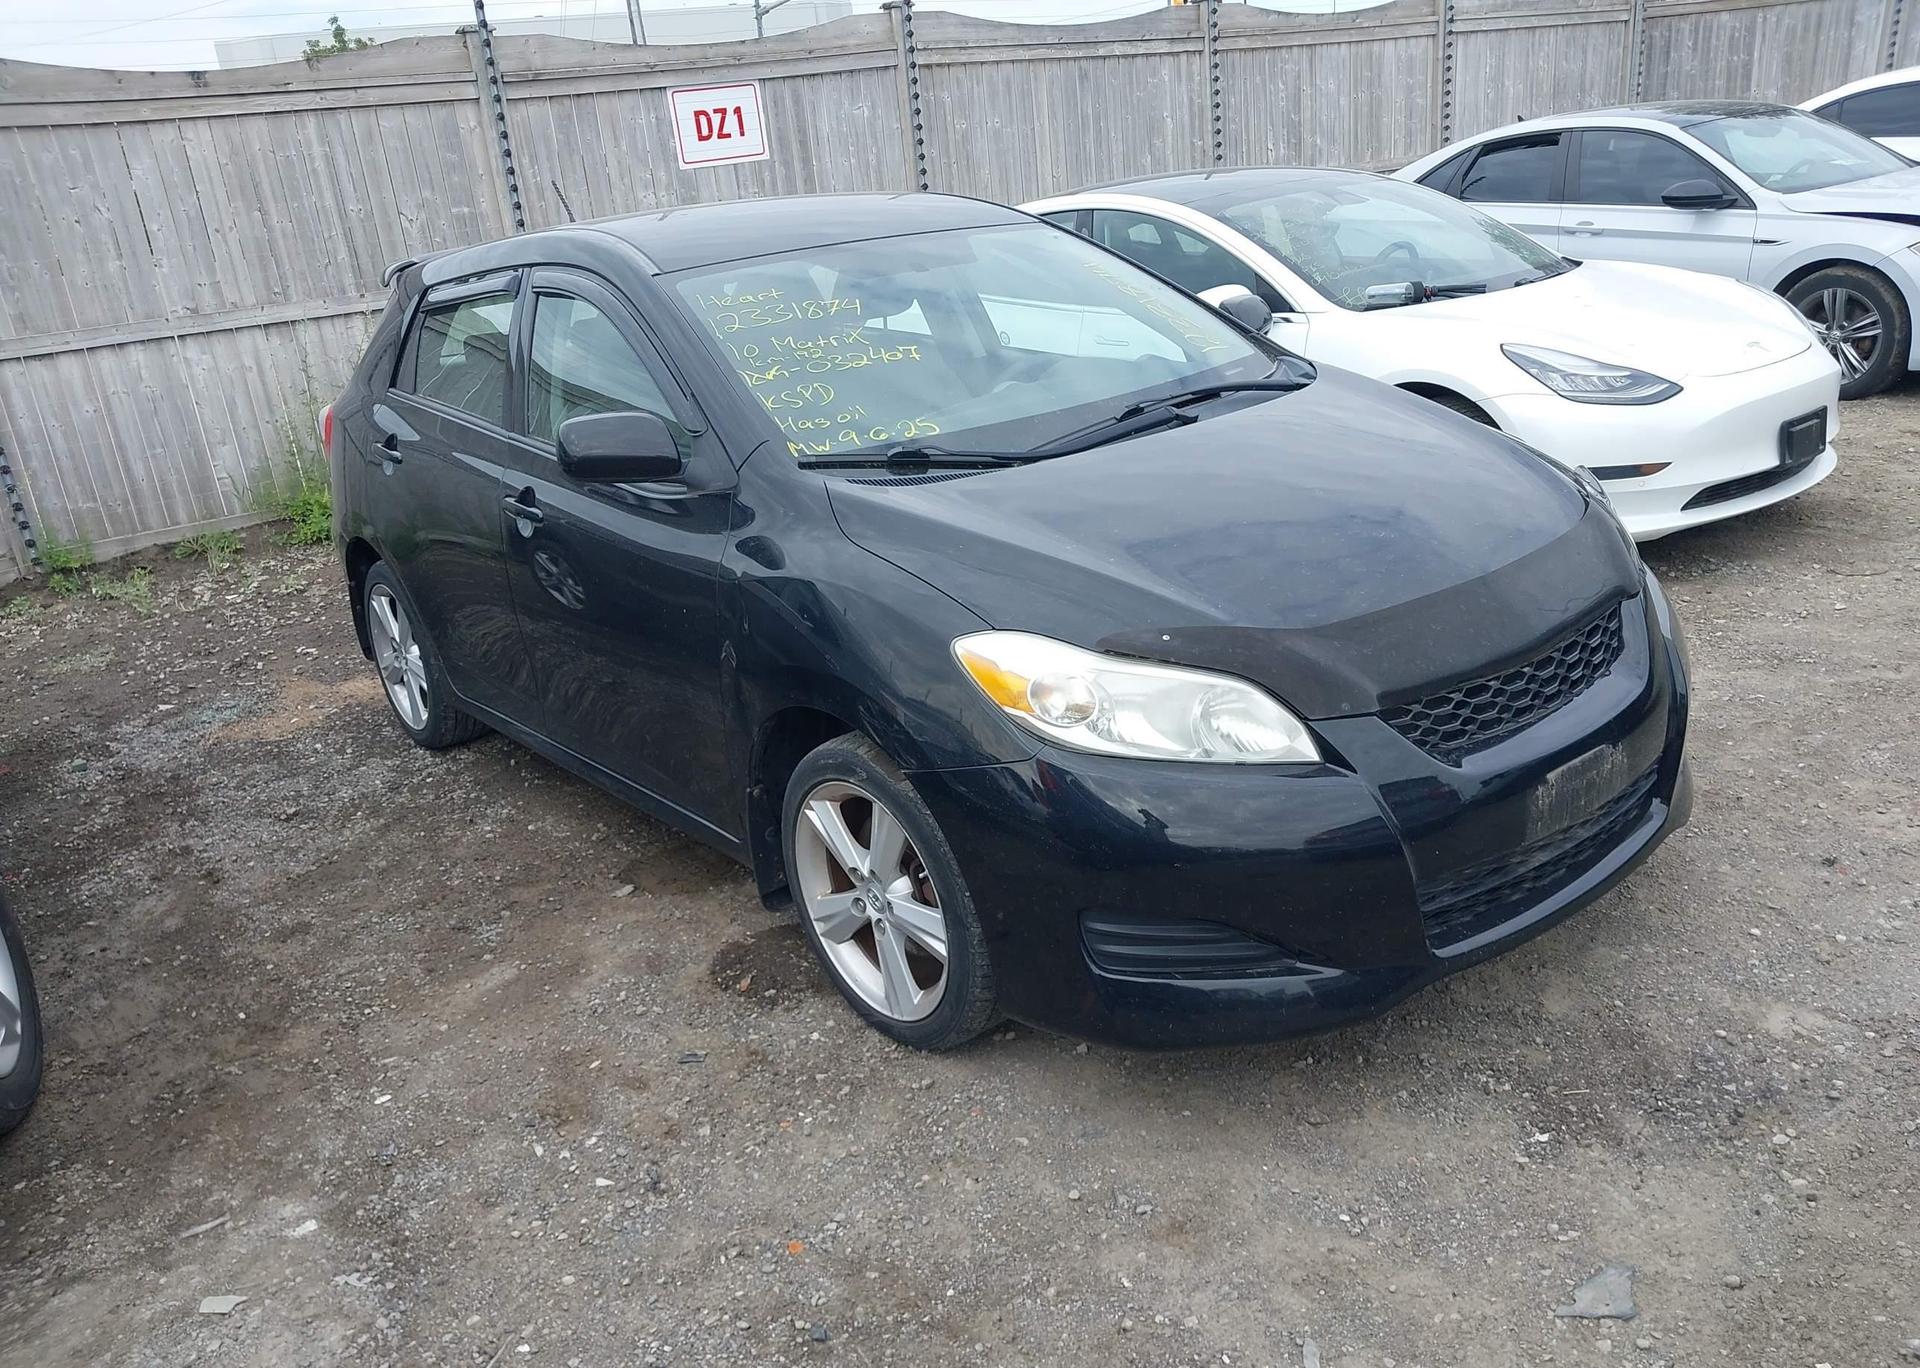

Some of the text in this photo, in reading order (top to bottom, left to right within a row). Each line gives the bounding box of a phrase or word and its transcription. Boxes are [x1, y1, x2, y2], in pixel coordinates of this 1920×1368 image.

[693, 106, 745, 142] DZ1
[696, 288, 784, 310] Heart
[708, 298, 862, 339] 12331874
[726, 342, 759, 360] 10
